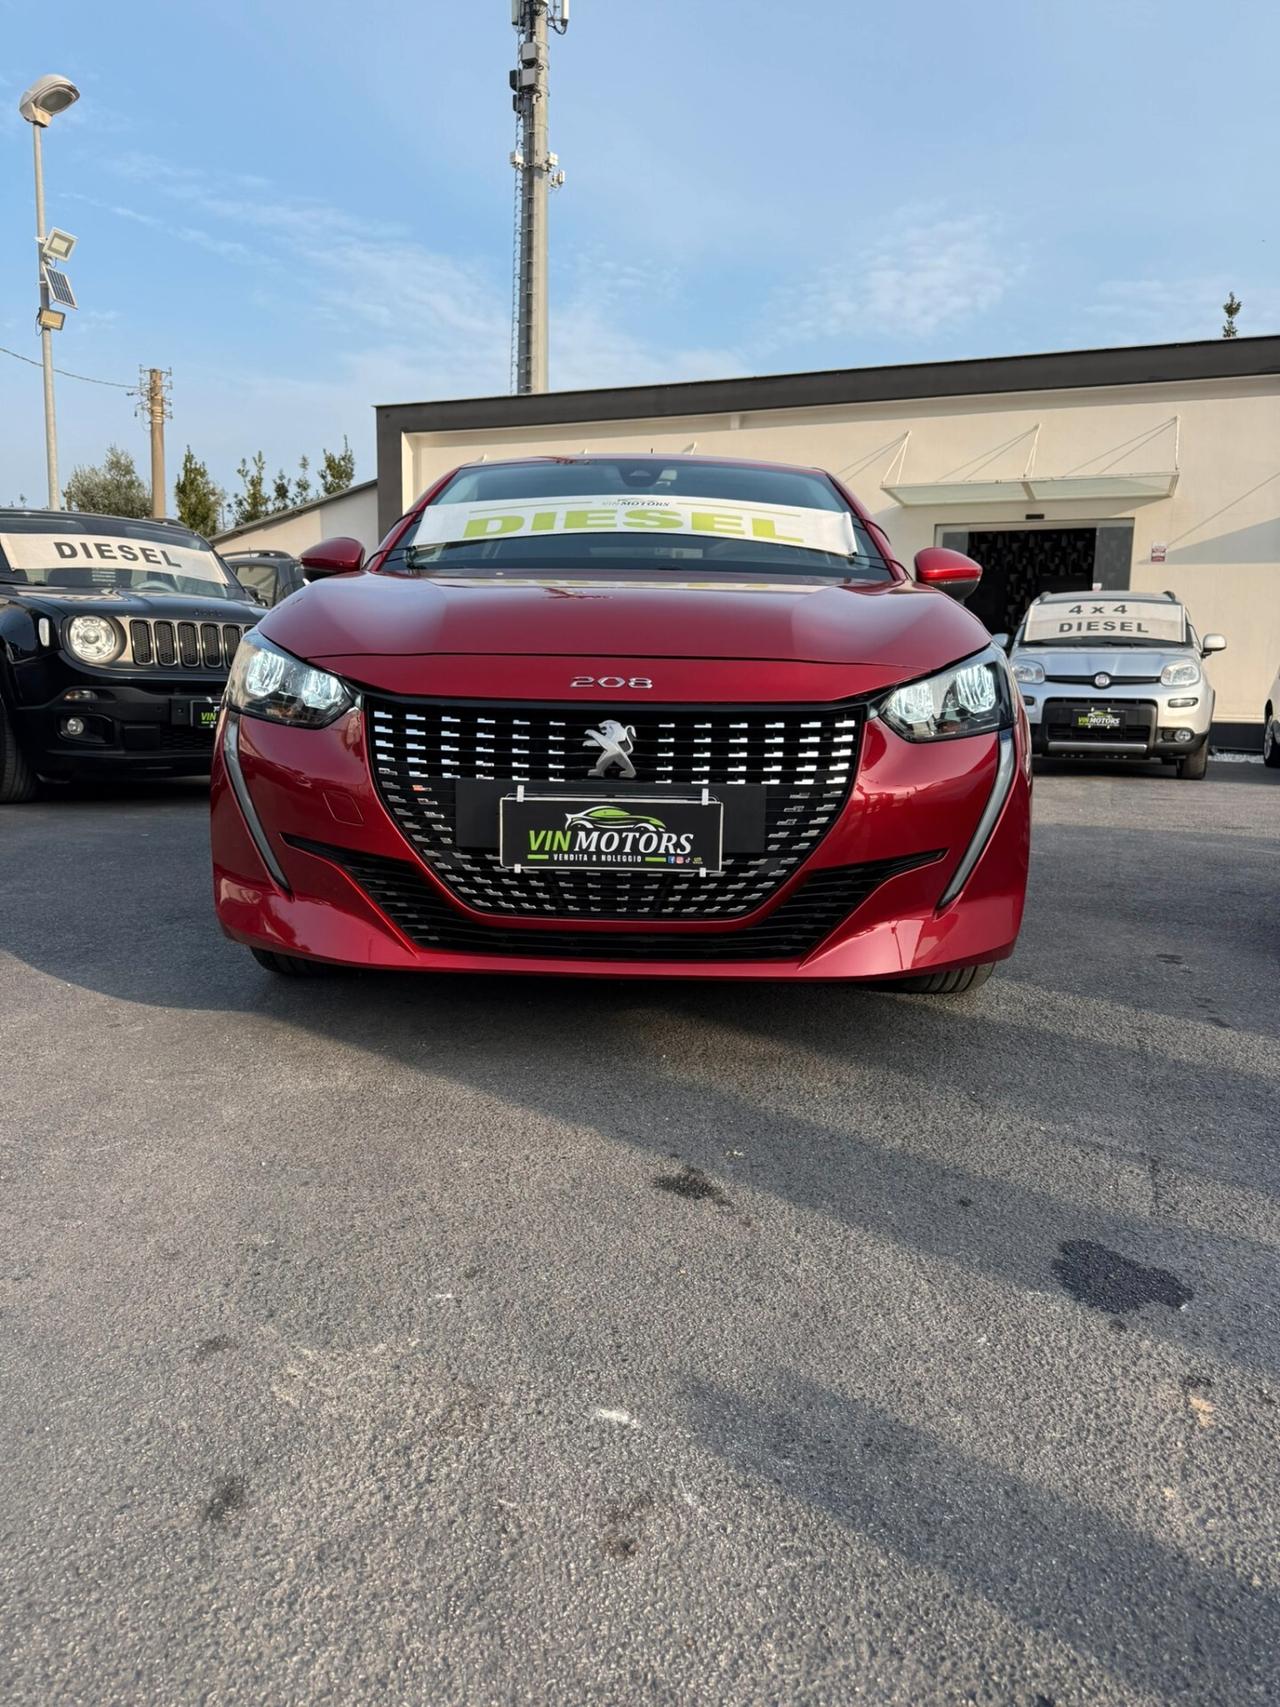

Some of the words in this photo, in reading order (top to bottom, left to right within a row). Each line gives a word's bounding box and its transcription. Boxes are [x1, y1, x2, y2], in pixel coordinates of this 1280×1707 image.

[463, 510, 804, 543] DIESEL
[53, 541, 182, 568] DIESEL
[1069, 604, 1083, 614] 4
[1113, 604, 1128, 614] 4
[1059, 621, 1149, 633] DIESEL
[569, 676, 654, 690] 208
[200, 712, 217, 721] VIN
[528, 830, 572, 852] VIN
[573, 831, 694, 854] MOTORS
[553, 853, 588, 862] VENDITA
[601, 854, 642, 863] NOLEGGIO
